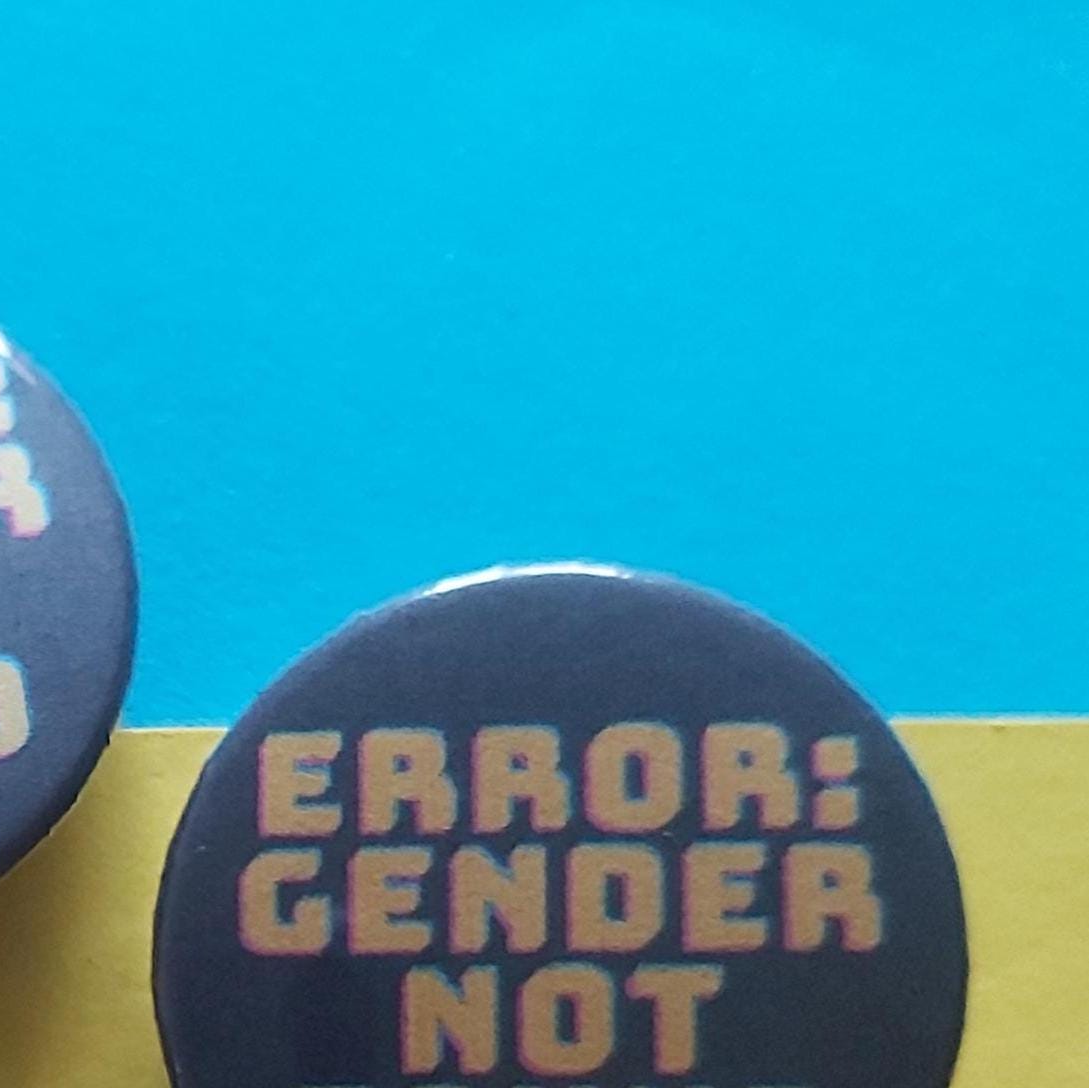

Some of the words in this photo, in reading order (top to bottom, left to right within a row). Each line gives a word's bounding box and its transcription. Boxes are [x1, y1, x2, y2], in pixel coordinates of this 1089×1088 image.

[257, 722, 861, 836] ERROR:
[237, 843, 884, 956] GENDER
[401, 964, 725, 1076] NOT
